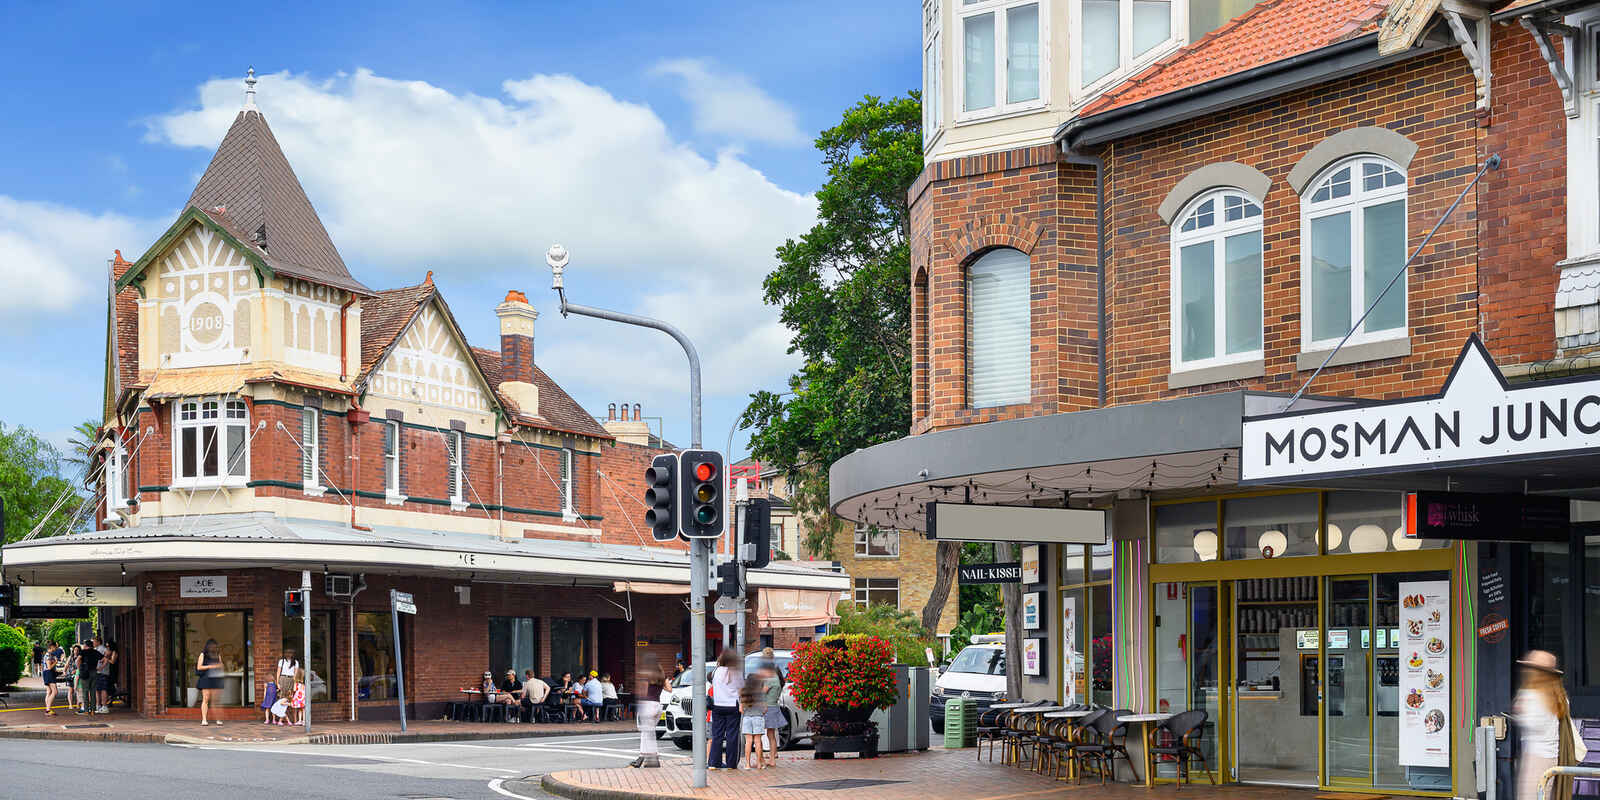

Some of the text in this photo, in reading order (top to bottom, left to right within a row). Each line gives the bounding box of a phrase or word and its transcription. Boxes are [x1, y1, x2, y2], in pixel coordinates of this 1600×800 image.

[192, 316, 222, 330] 1908
[1265, 394, 1600, 466] MOSMAN JUNC
